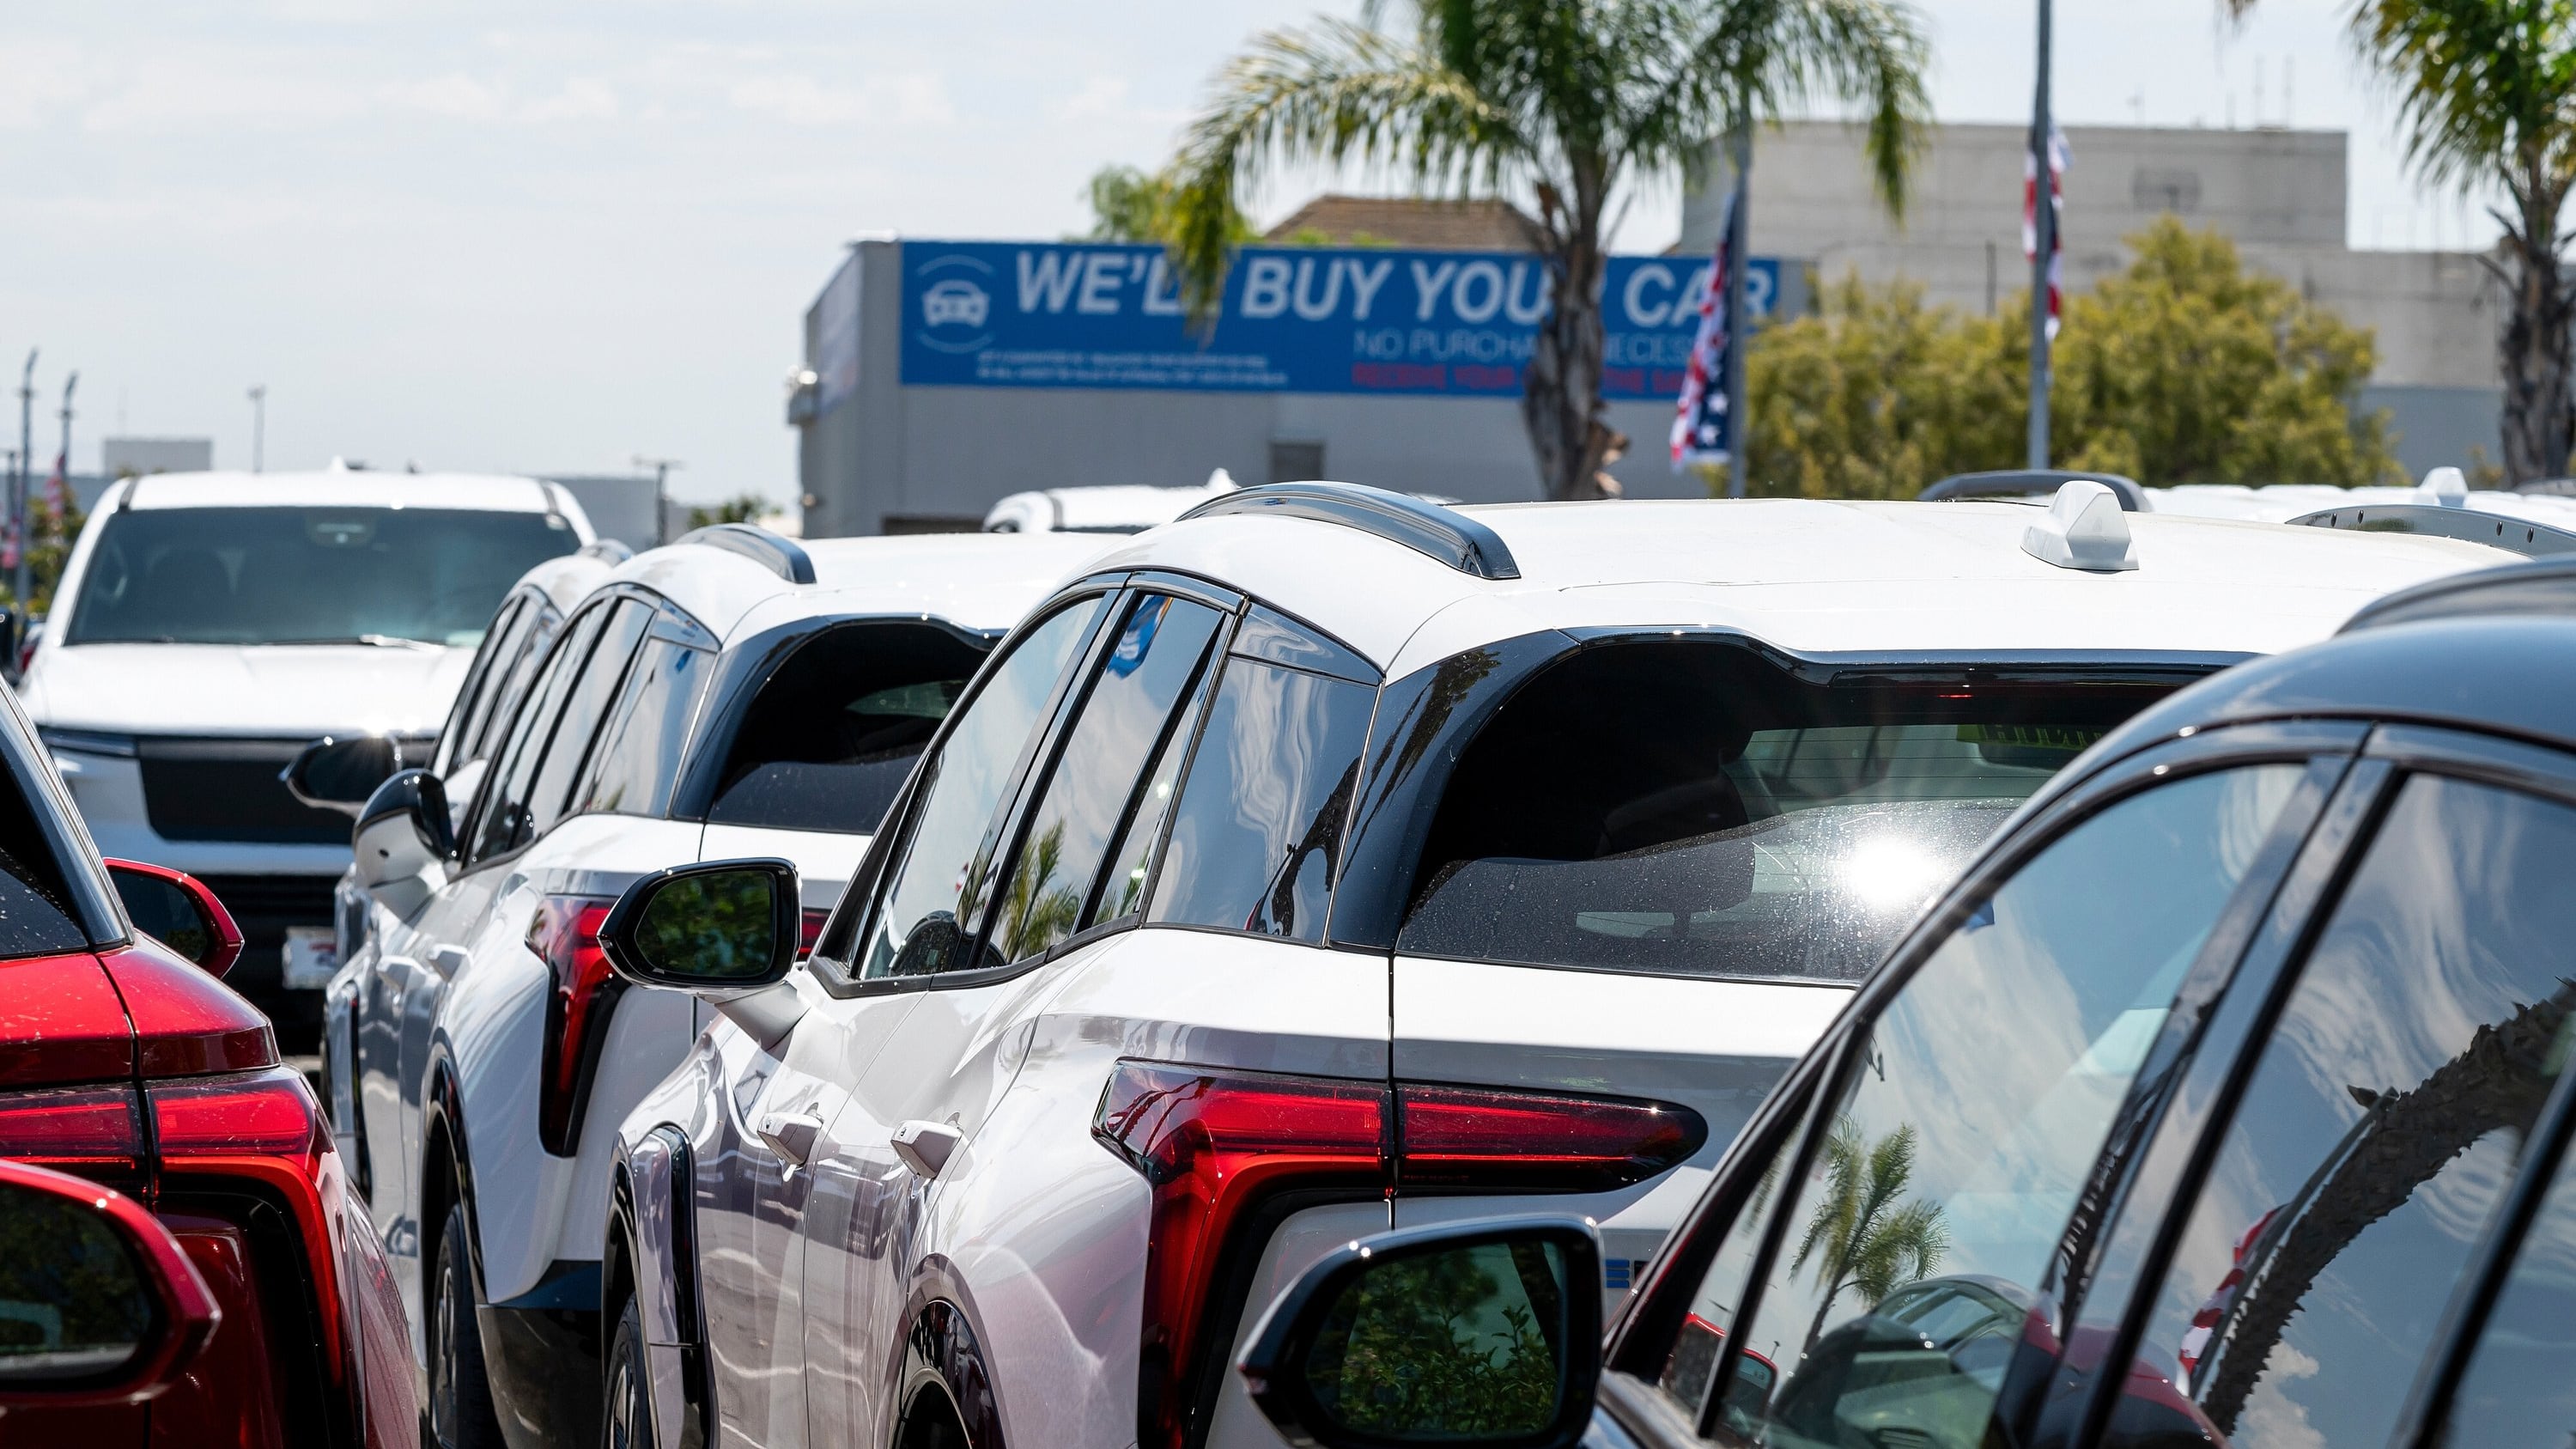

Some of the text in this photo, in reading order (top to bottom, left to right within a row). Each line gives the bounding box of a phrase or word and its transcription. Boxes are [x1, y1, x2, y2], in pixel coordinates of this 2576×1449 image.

[1016, 252, 1223, 317] WE'L
[1240, 257, 1394, 322] BUY
[1409, 260, 1606, 326] YOU
[1354, 329, 1405, 360] NO
